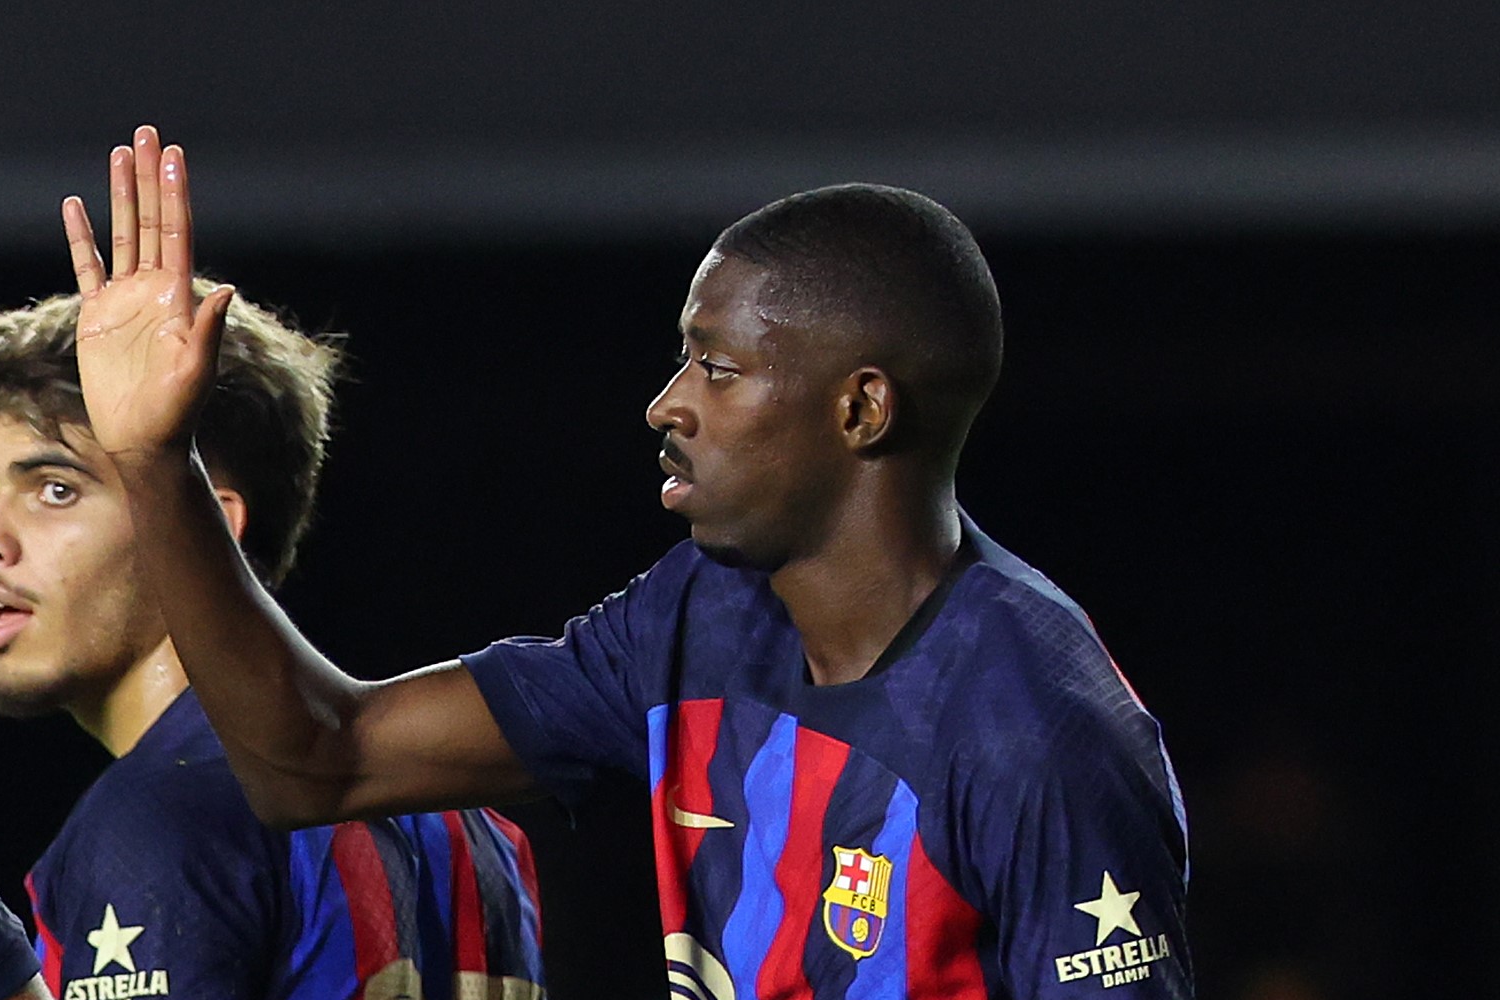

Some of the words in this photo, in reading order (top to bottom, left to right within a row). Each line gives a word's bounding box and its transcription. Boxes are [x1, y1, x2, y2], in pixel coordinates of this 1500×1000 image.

[851, 893, 876, 912] FCB
[1055, 933, 1170, 982] ESTRELLA
[1102, 965, 1150, 988] DAMM
